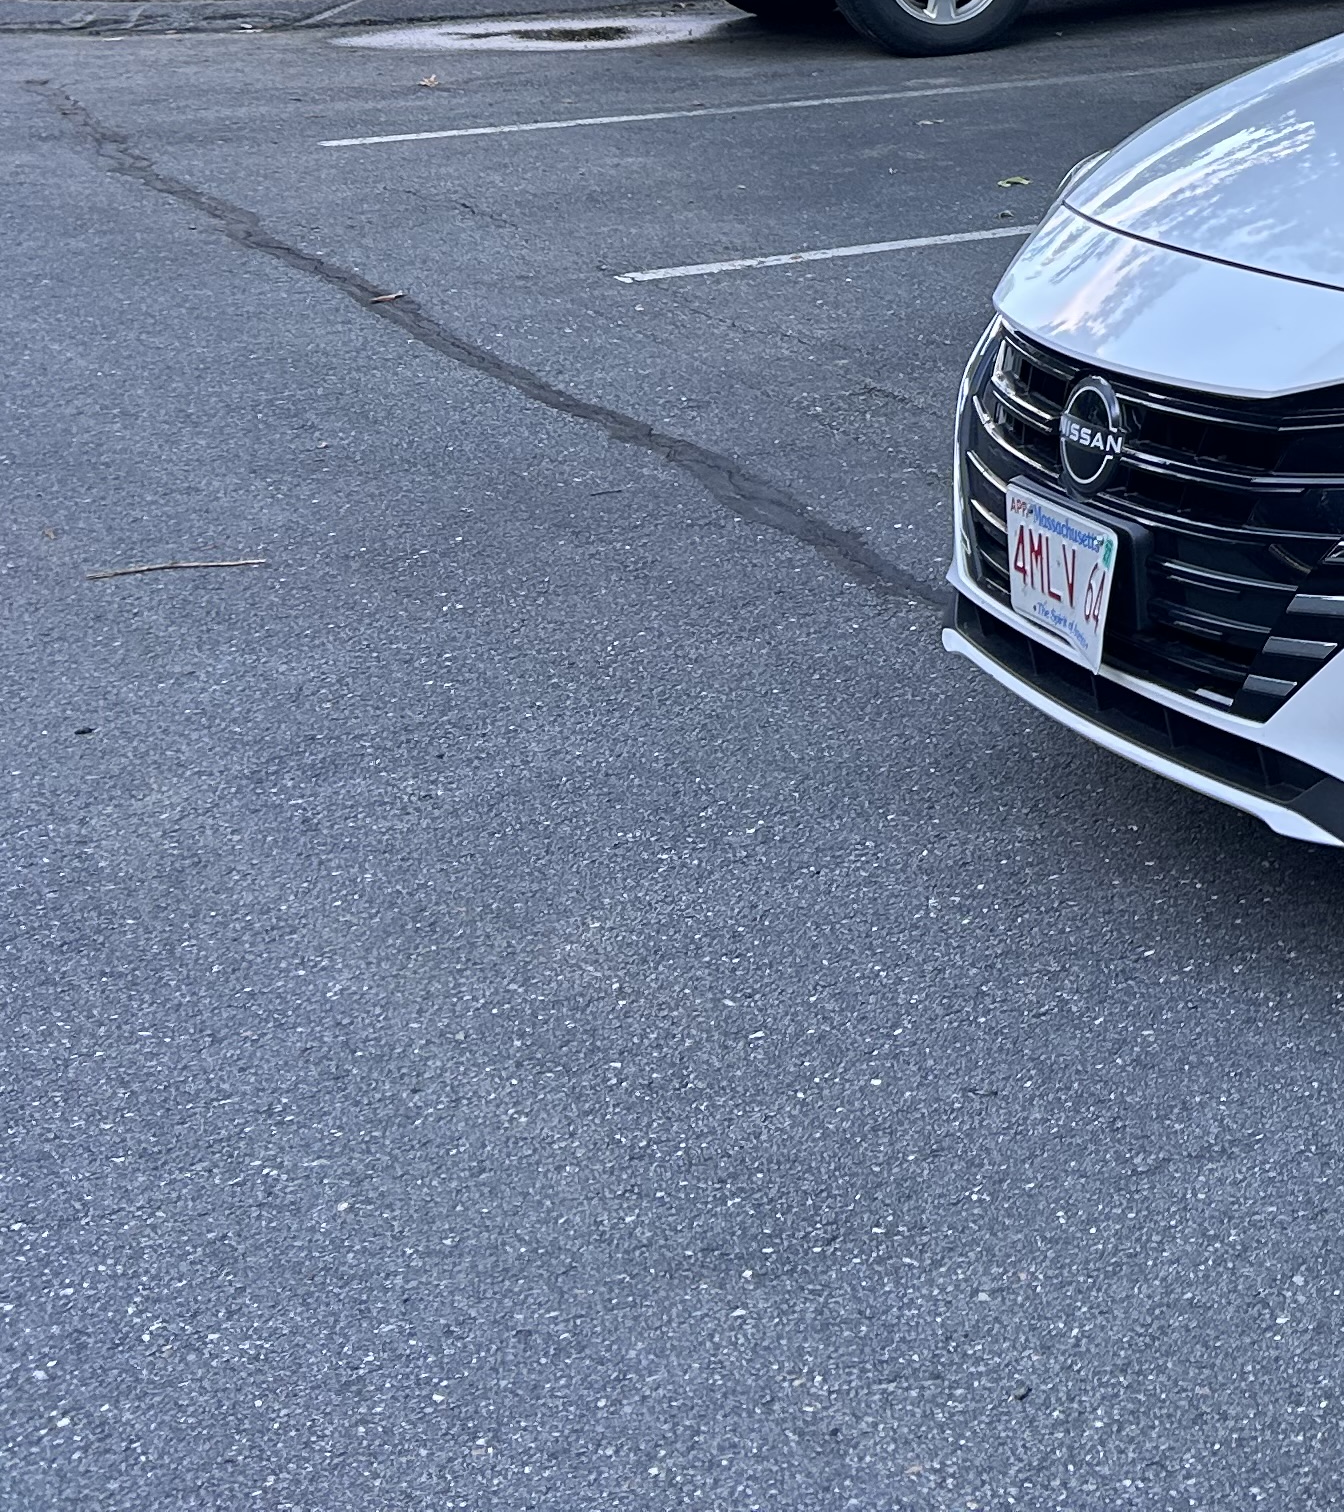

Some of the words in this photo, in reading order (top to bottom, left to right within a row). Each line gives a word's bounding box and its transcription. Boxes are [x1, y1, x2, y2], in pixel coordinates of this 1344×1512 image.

[1060, 416, 1122, 454] NISSAN
[1032, 502, 1100, 554] Massachusetts
[1014, 523, 1077, 608] 4MLV
[1083, 561, 1107, 635] 64
